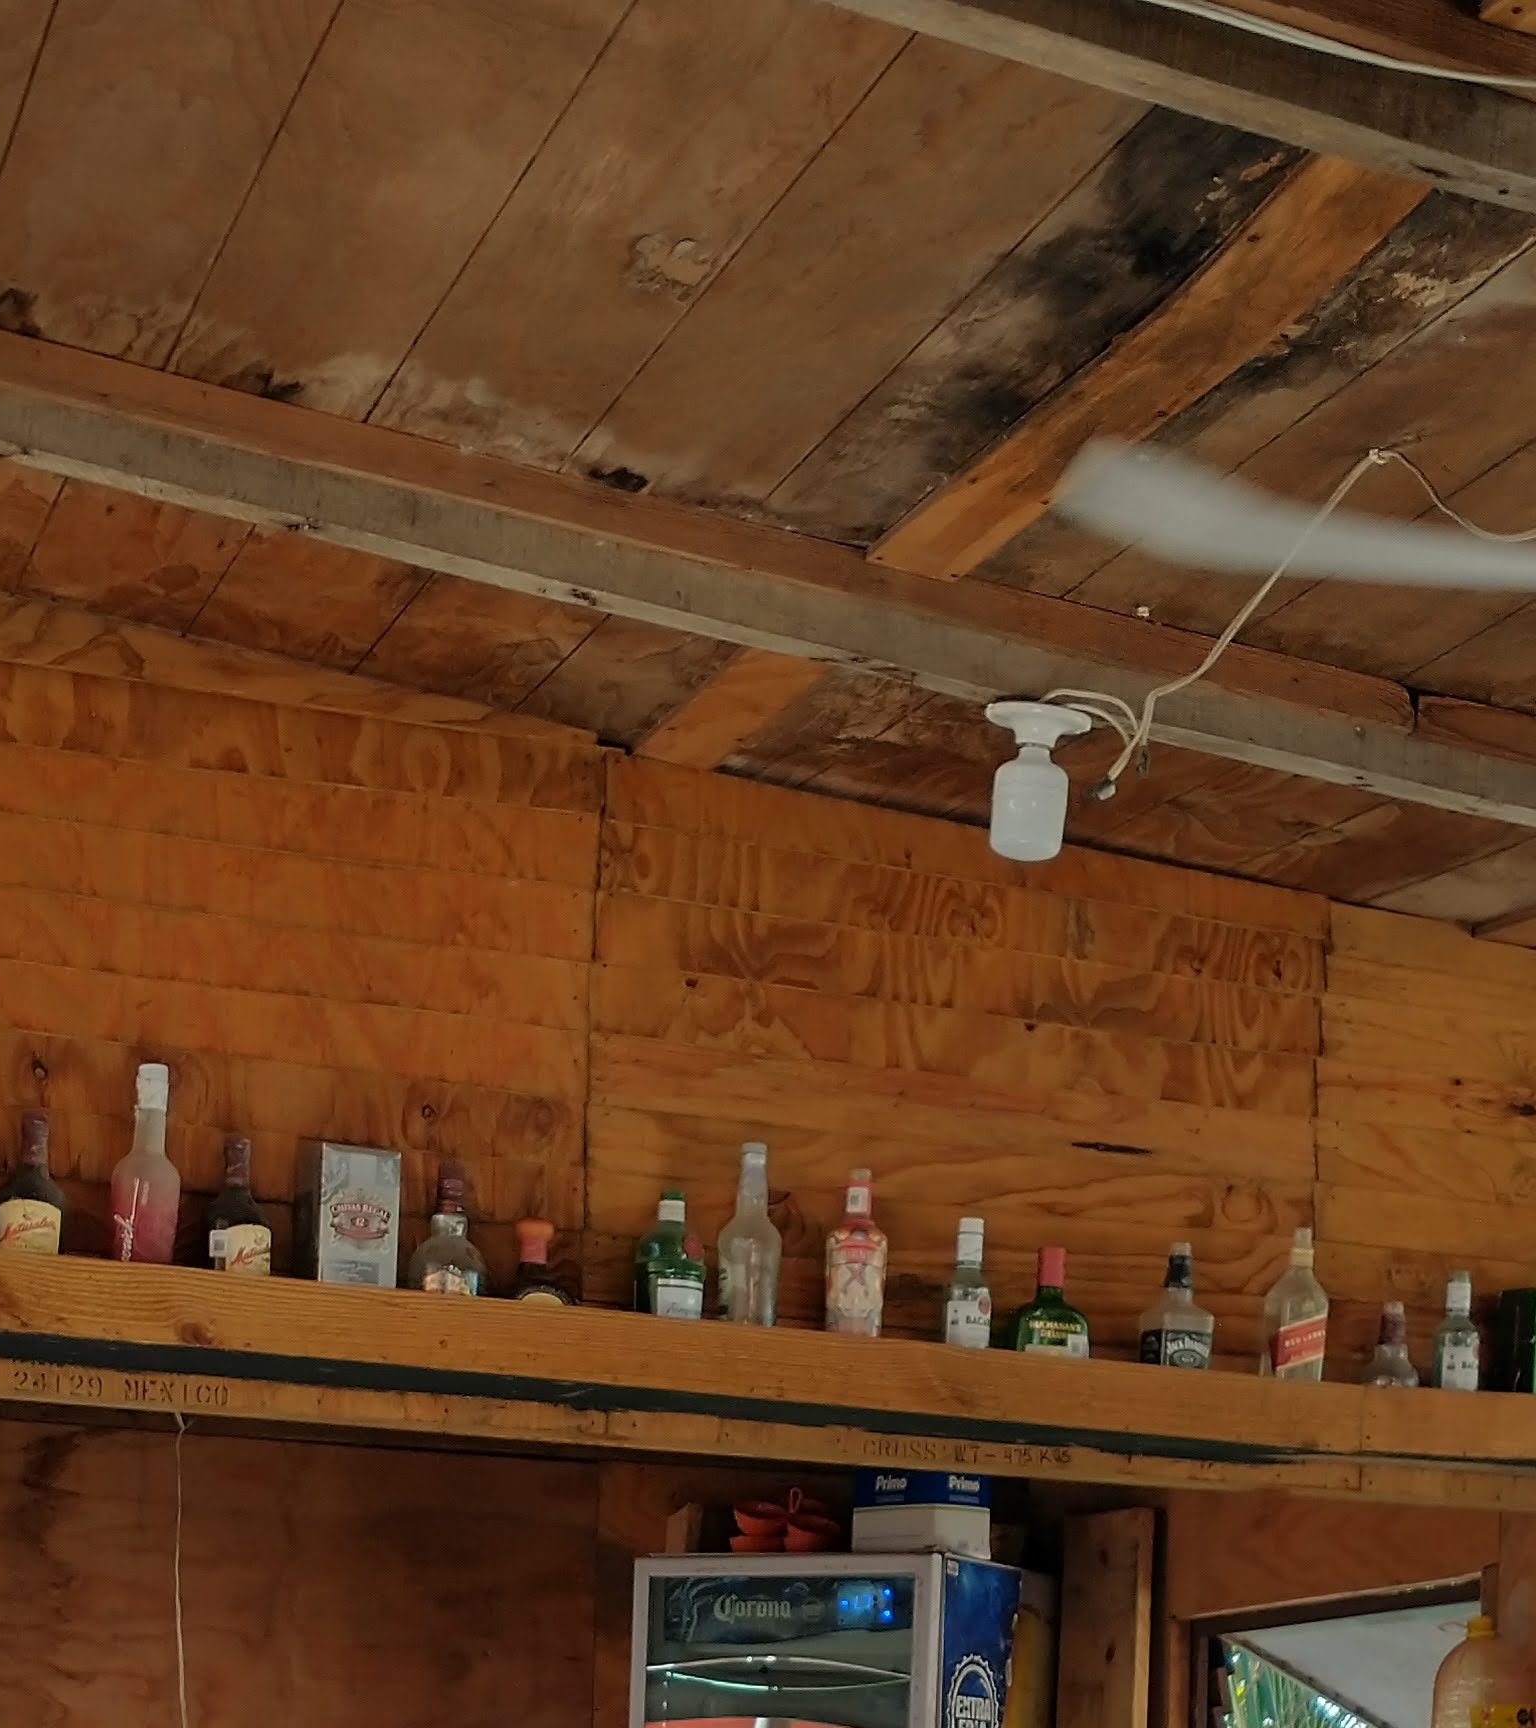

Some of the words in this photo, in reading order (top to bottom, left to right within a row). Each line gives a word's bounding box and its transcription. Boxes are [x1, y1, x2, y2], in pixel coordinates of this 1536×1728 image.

[14, 1371, 103, 1398] 24129
[124, 1378, 229, 1406] MEXICO
[874, 1474, 908, 1492] Primo
[947, 1474, 981, 1493] Primo
[714, 1593, 792, 1624] Corona
[956, 1695, 991, 1721] EXTRA
